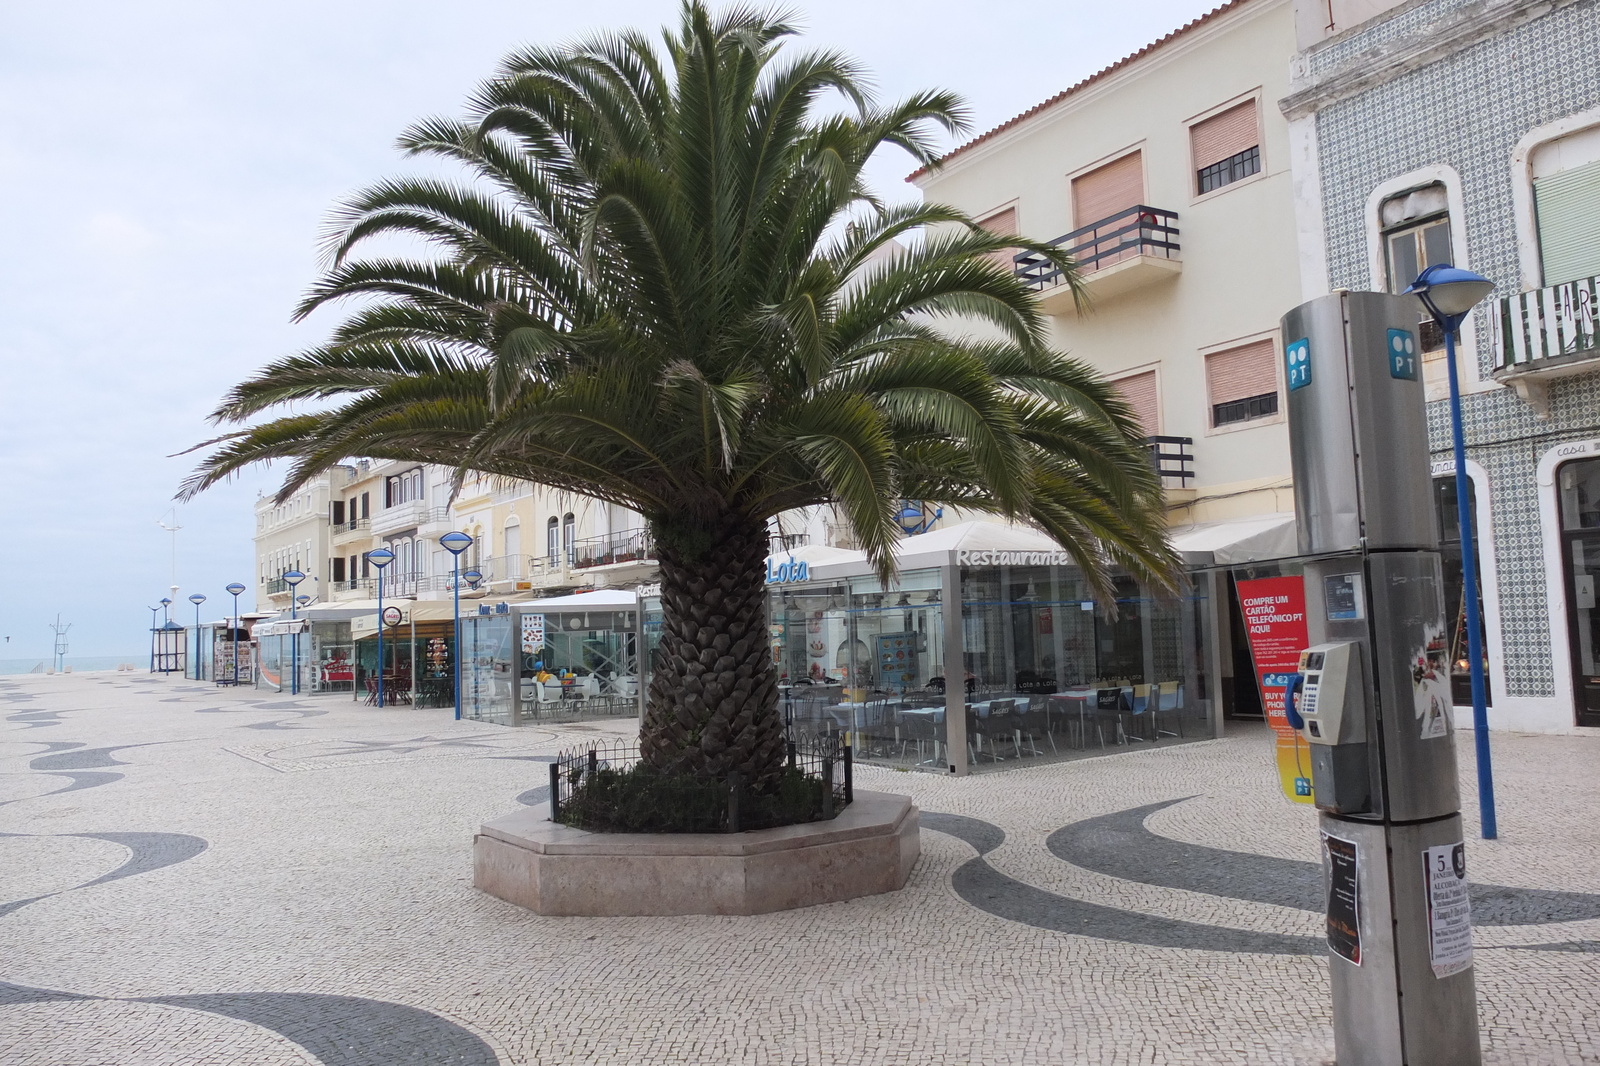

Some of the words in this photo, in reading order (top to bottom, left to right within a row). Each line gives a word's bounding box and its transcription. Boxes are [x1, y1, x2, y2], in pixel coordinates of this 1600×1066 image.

[1564, 280, 1600, 333] AR
[1395, 356, 1414, 374] PT
[1291, 365, 1306, 384] PT
[1557, 444, 1587, 457] casa
[956, 547, 1069, 567] Restaurante
[766, 555, 810, 584] Lota
[1243, 596, 1274, 606] COMPRE
[1275, 595, 1289, 604] UM
[1245, 604, 1275, 616] CARTÃO
[1293, 613, 1303, 622] PT
[1265, 692, 1279, 700] BUY
[1437, 854, 1446, 872] 5
